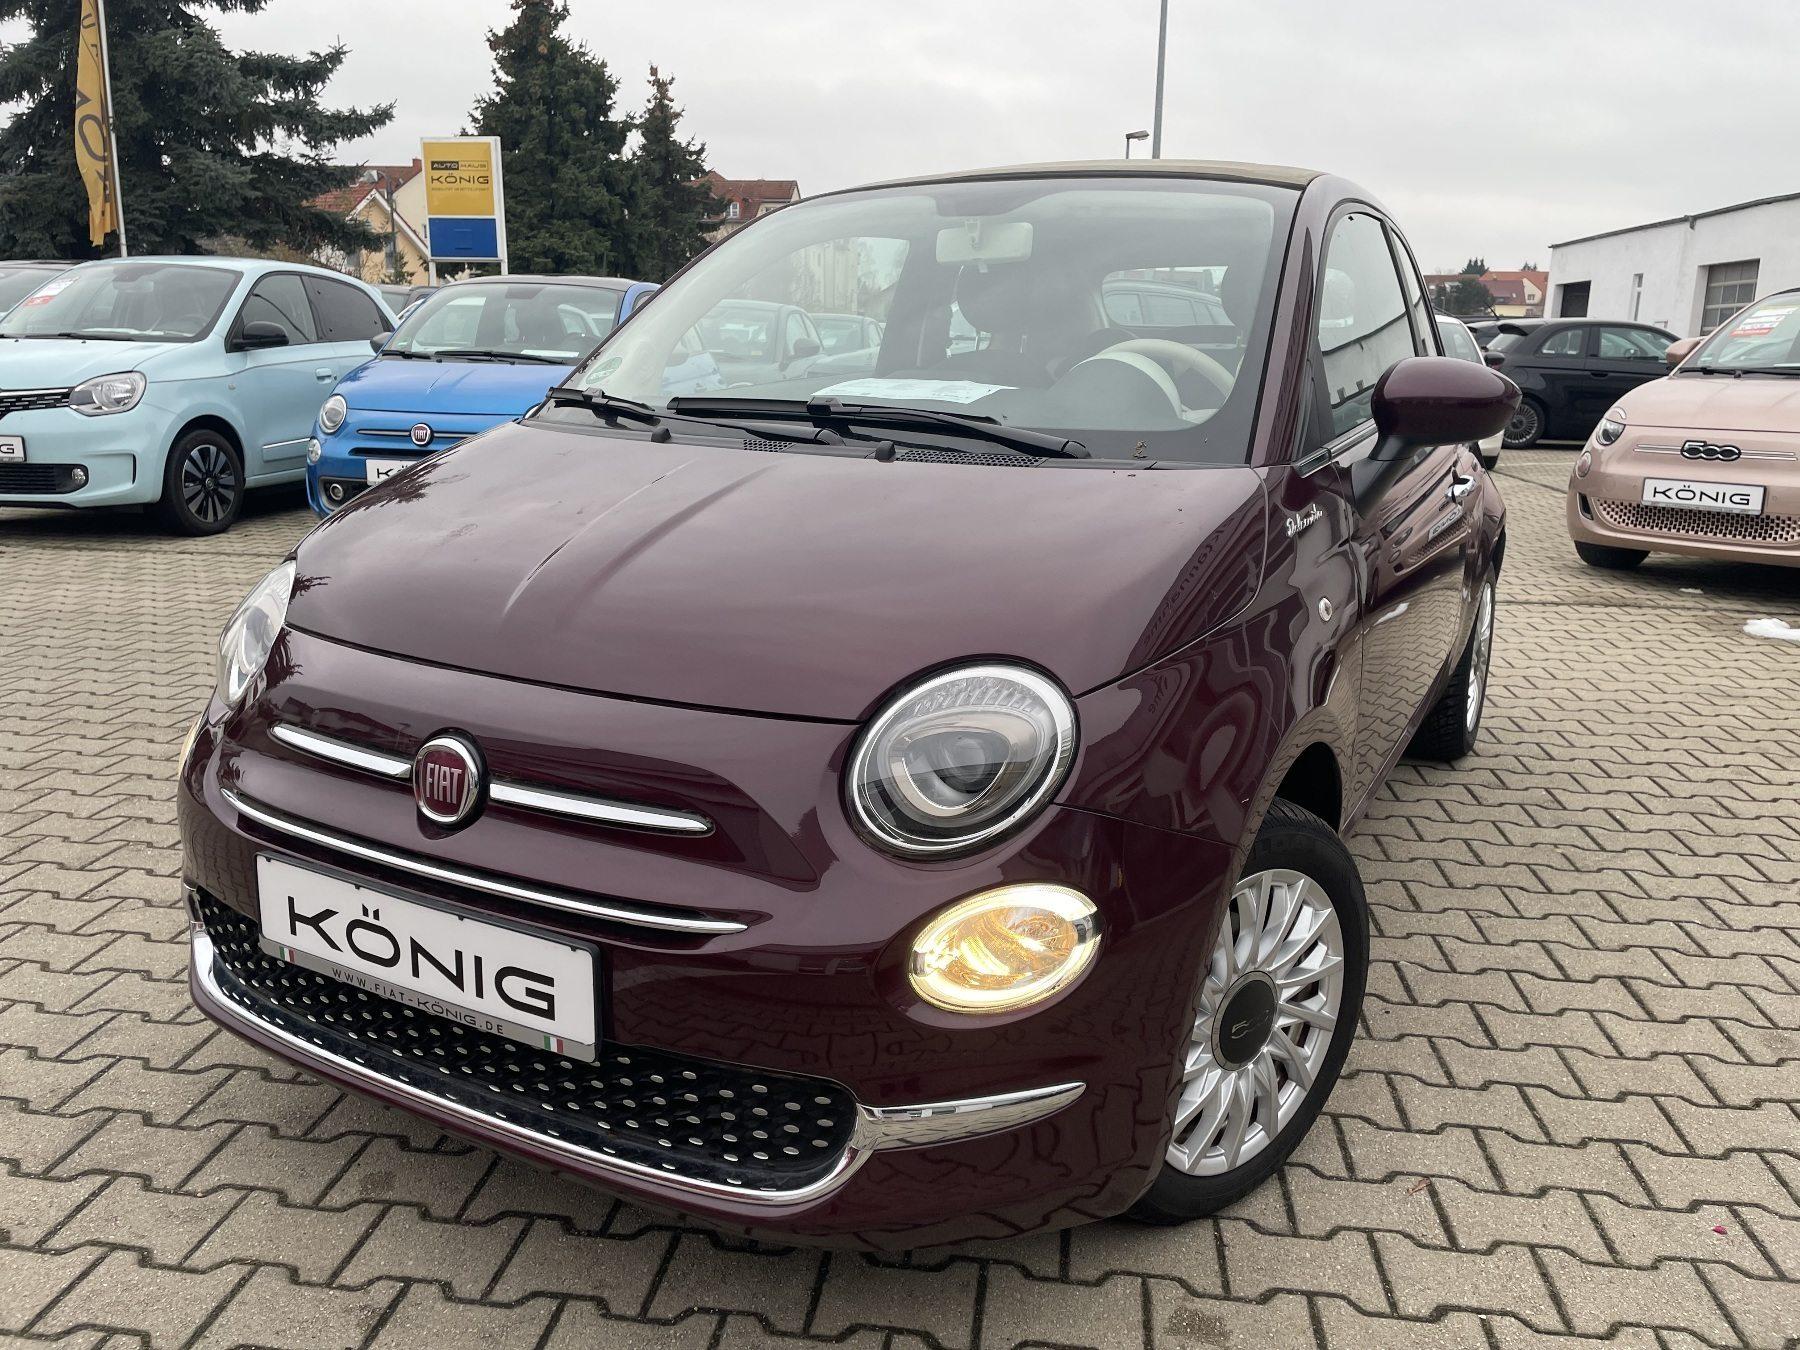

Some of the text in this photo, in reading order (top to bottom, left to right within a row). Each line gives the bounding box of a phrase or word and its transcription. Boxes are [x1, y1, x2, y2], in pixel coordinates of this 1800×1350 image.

[430, 172, 490, 185] KÖNIG
[1681, 440, 1741, 461] 500
[1652, 484, 1751, 506] KÖNIG
[425, 762, 463, 804] FIAT
[287, 895, 556, 1022] KÖNIG
[332, 967, 504, 1035] WWW.FIAT-KÖNIG.DE
